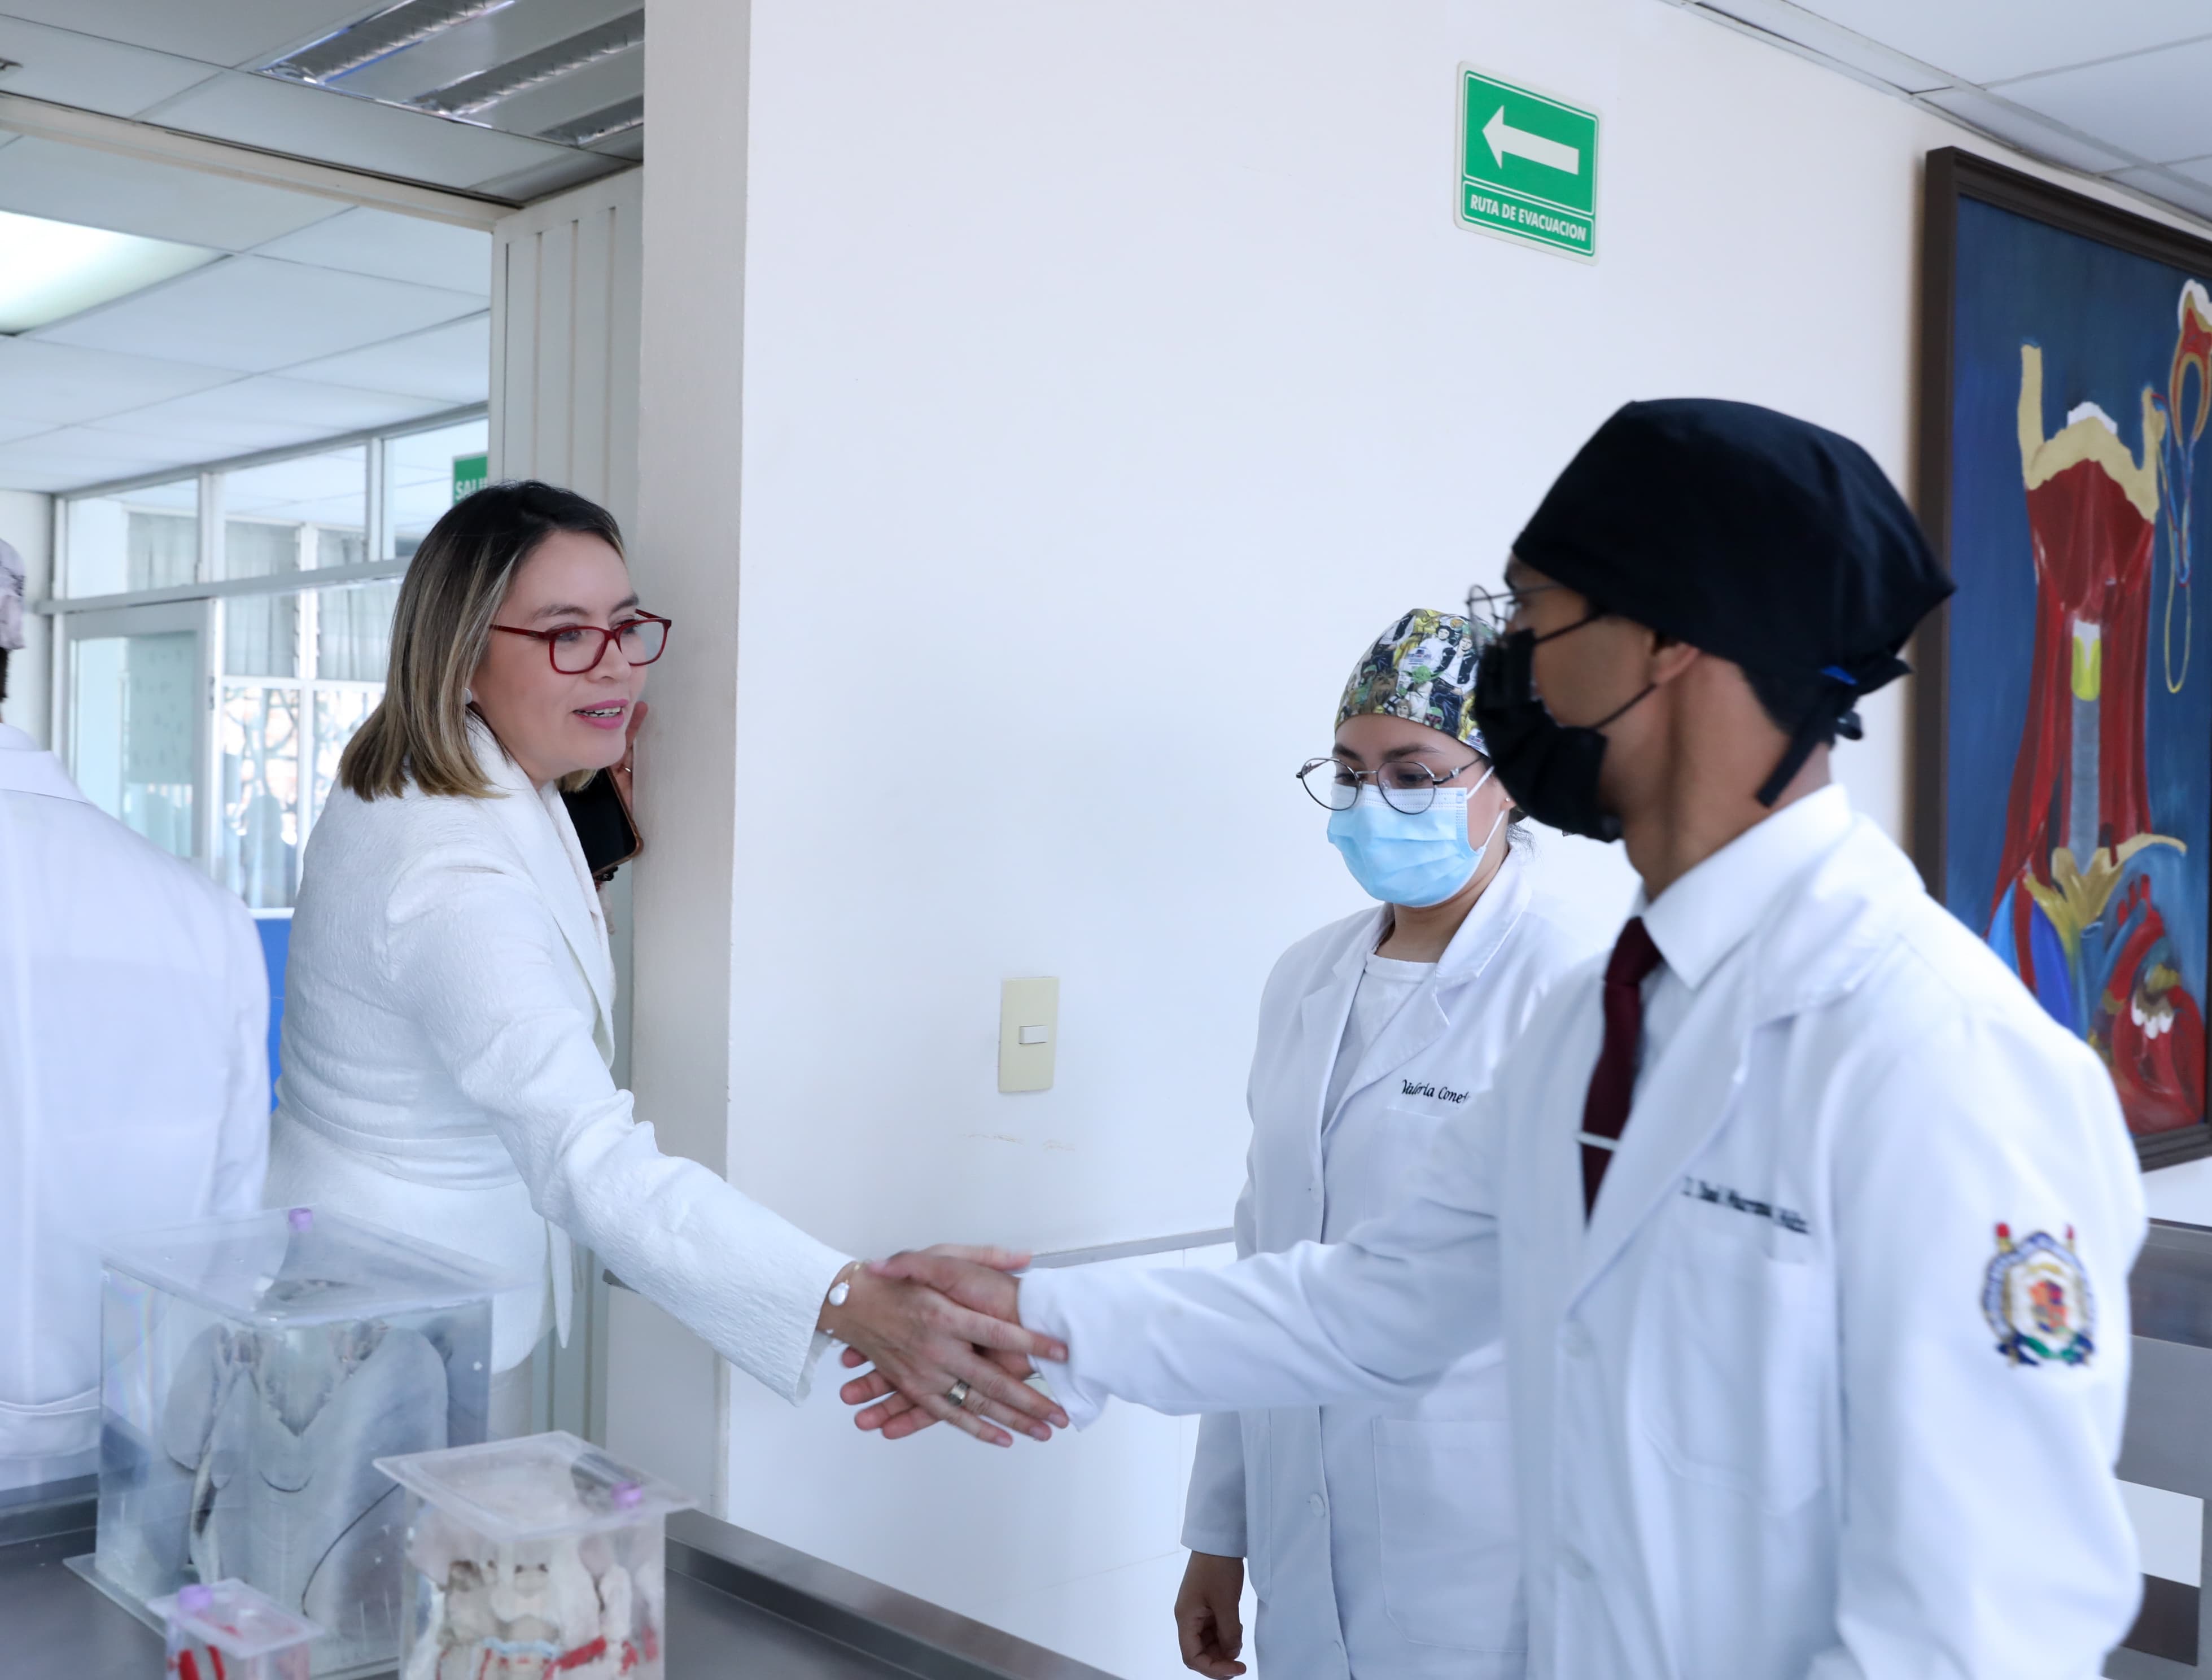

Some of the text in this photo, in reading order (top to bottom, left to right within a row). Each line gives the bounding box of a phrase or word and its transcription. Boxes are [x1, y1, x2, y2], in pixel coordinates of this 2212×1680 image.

[1470, 194, 1587, 242] RUTA DE EVACUACION
